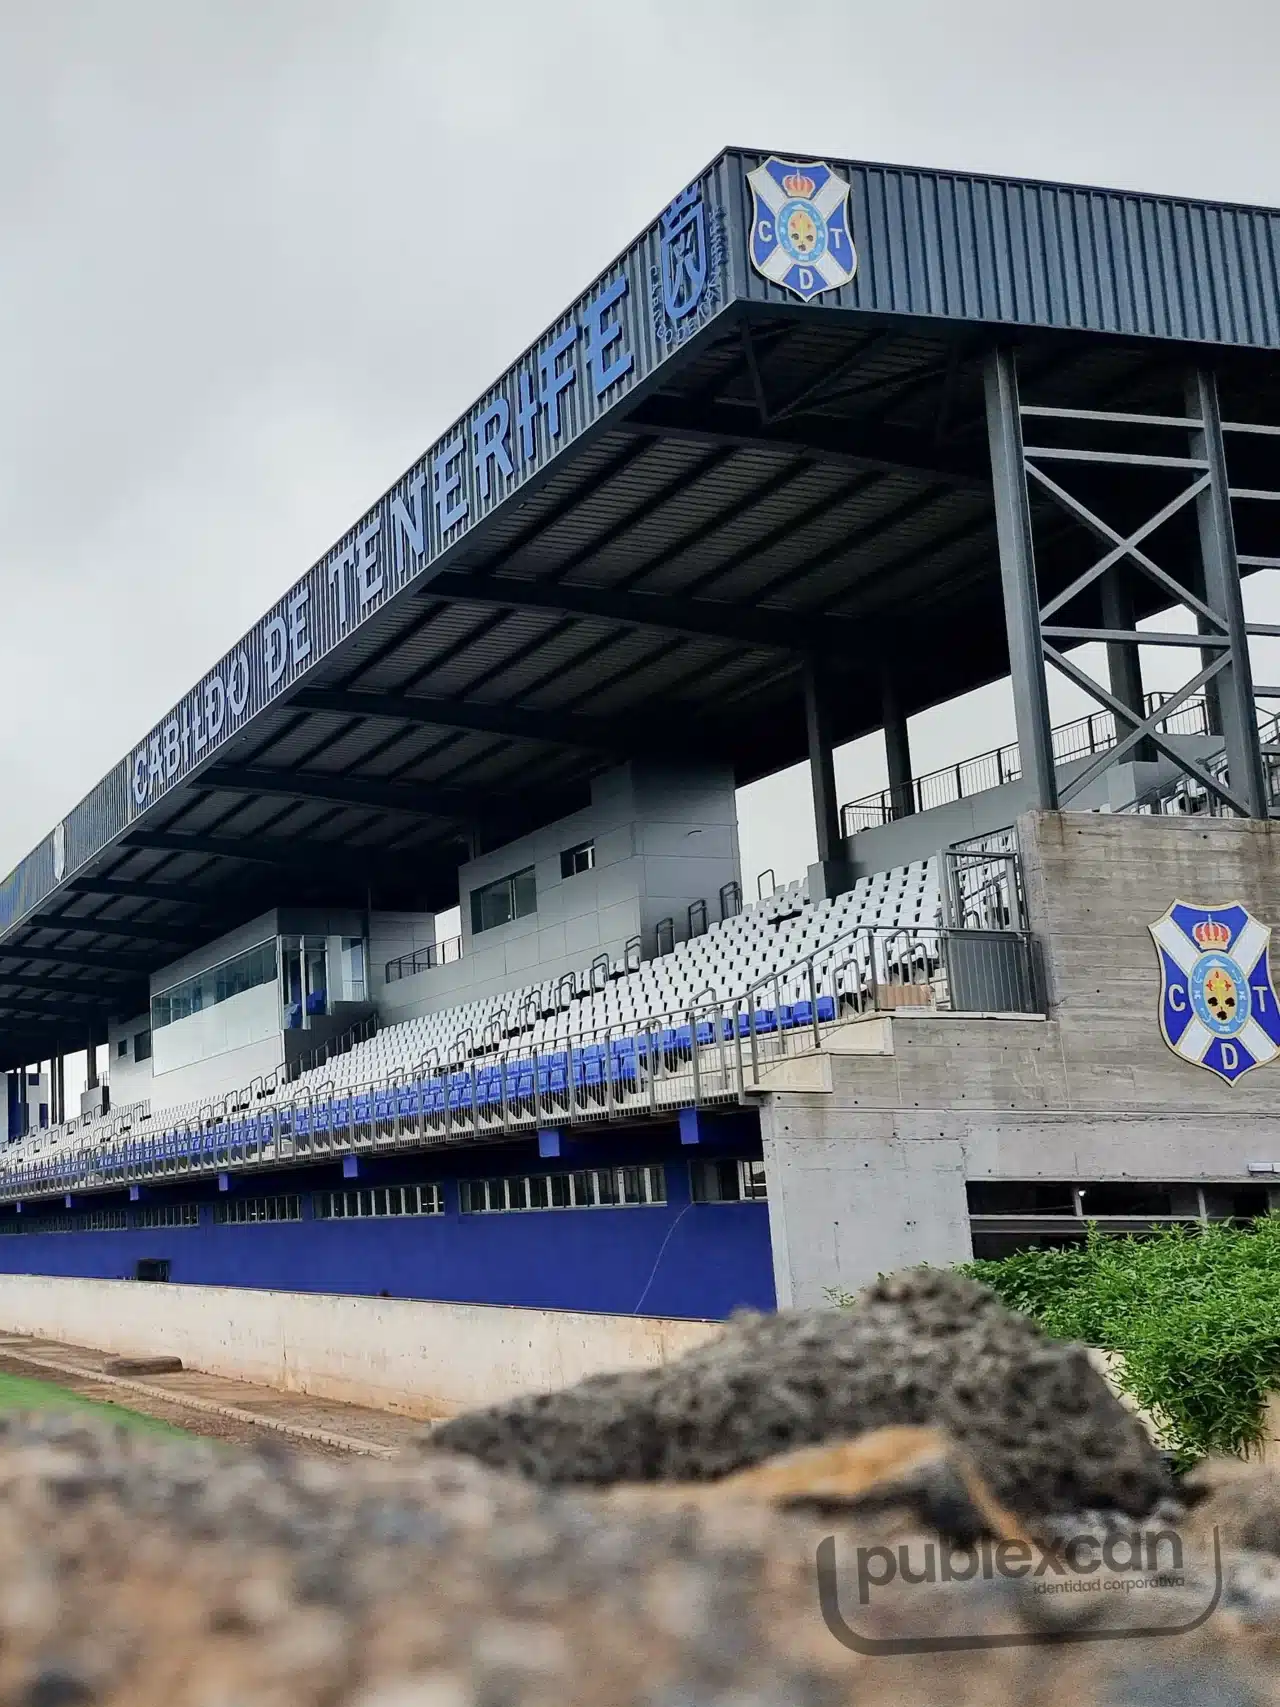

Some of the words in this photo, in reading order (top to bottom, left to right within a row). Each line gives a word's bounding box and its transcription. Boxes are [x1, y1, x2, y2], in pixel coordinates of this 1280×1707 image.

[758, 220, 773, 242] C
[829, 228, 843, 249] T
[798, 268, 814, 290] D
[131, 648, 250, 805] CABILDO
[263, 583, 312, 689] DE
[328, 273, 634, 626] TENERIFE
[1168, 983, 1186, 1012] C
[1252, 985, 1269, 1013] T
[1220, 1042, 1239, 1070] D
